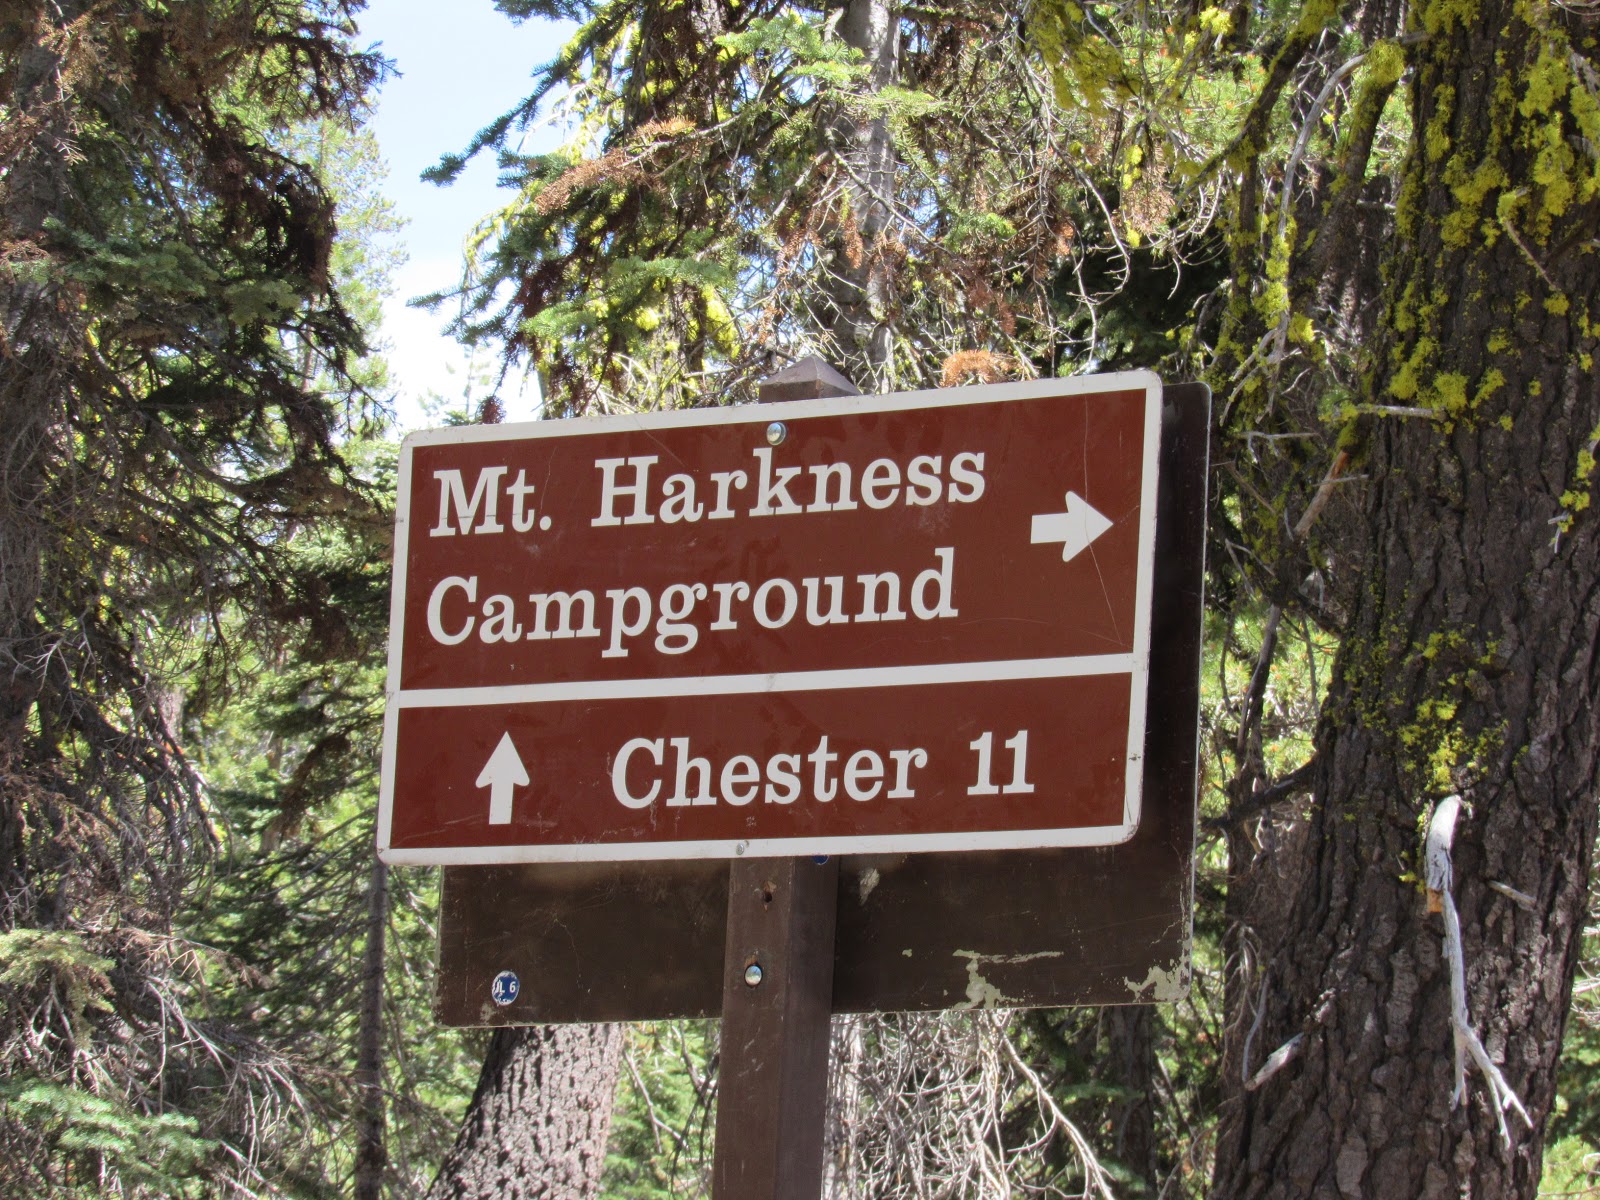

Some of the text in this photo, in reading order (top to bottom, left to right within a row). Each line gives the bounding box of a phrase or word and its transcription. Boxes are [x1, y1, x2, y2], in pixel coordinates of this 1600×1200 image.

[429, 447, 986, 537] Mt. Harkness
[427, 547, 959, 658] Campground
[611, 730, 1035, 809] Chester 11
